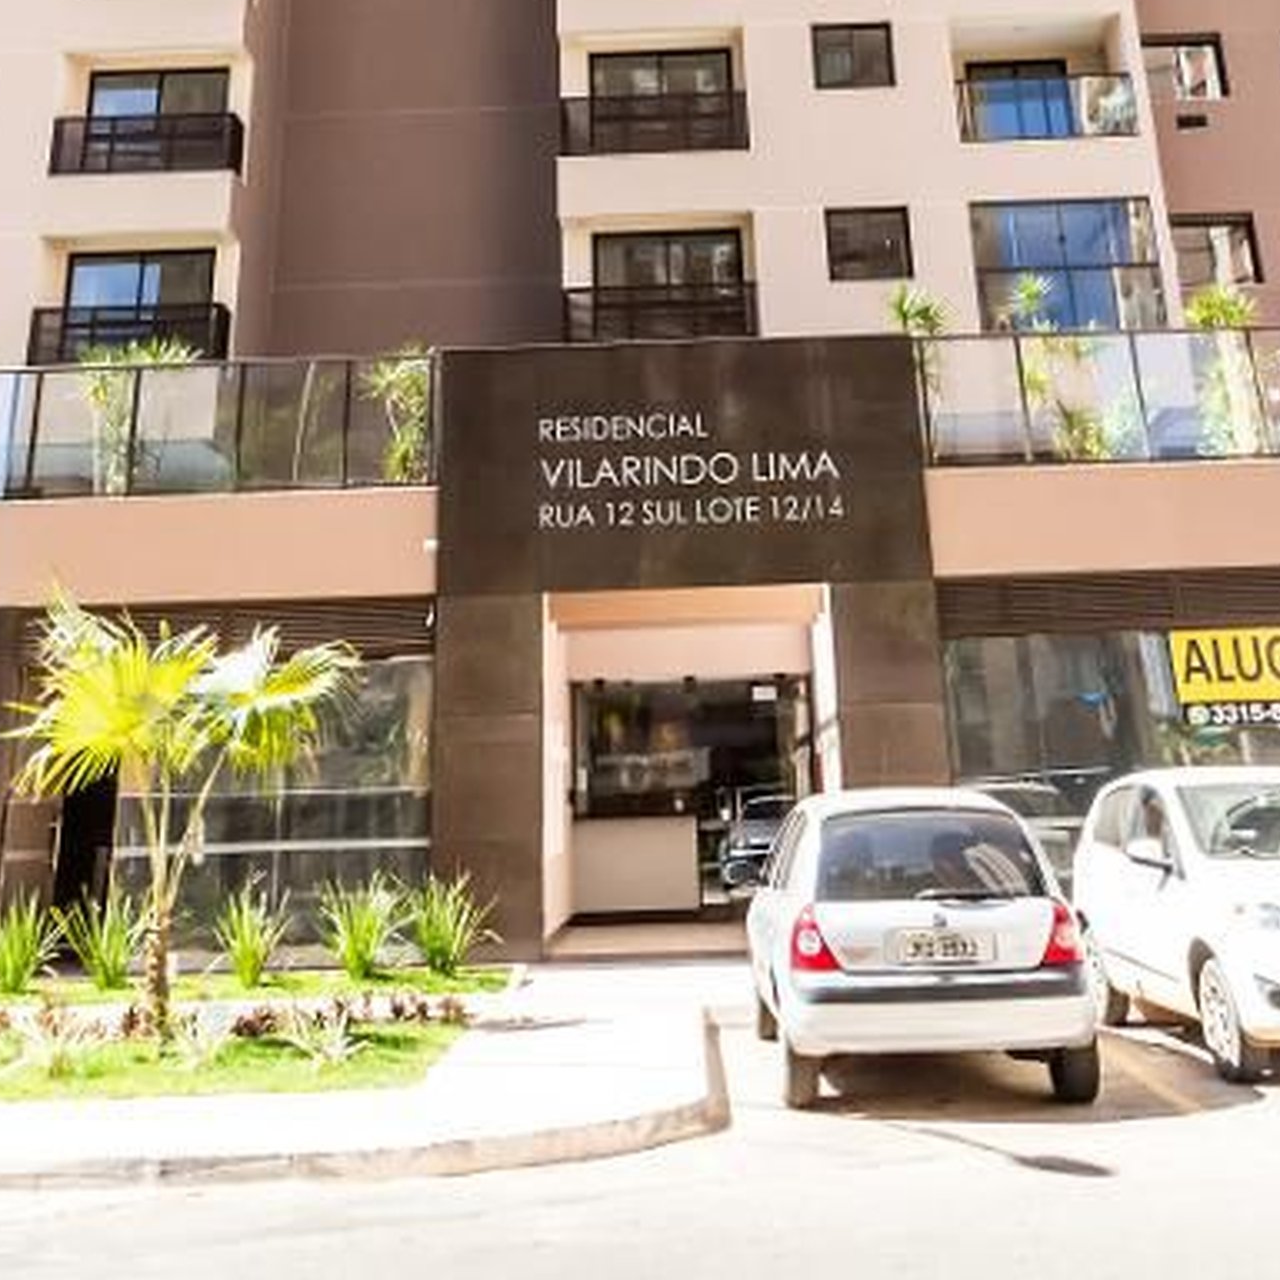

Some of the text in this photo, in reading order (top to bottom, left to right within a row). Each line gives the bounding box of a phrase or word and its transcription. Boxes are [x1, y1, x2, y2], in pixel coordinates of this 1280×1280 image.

[538, 413, 709, 442] RESIDENCIAL
[541, 450, 839, 488] VILARINDO LIMA
[539, 493, 845, 529] RUA 12 SUL LOTE 12/14
